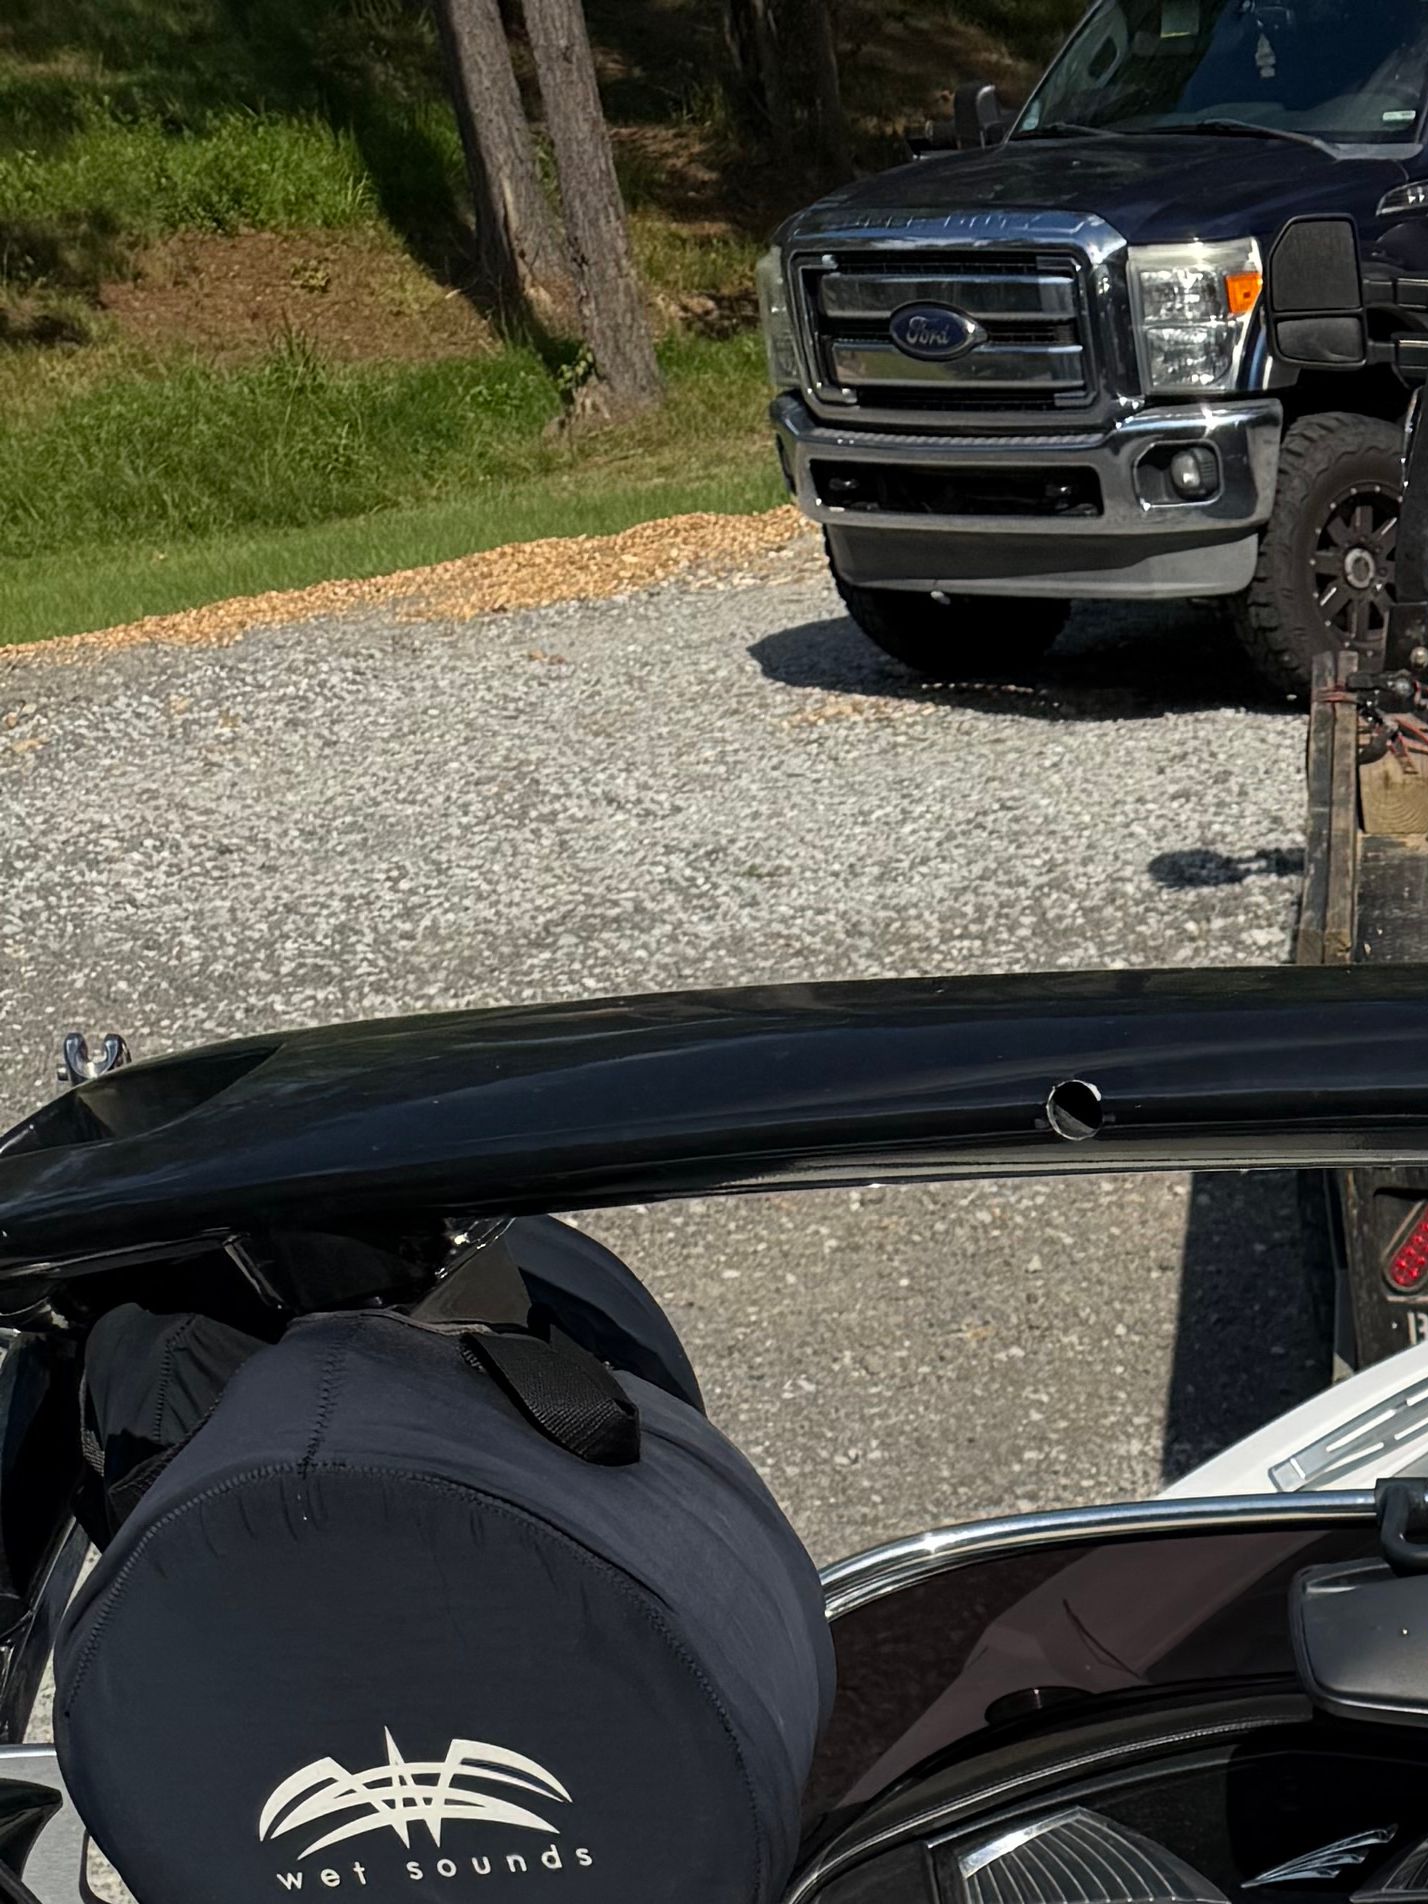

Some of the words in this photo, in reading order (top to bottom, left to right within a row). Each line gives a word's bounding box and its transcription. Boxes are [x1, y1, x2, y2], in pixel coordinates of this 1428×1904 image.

[905, 315, 951, 346] Ford
[276, 1861, 368, 1891] wet
[406, 1844, 593, 1881] sounds
